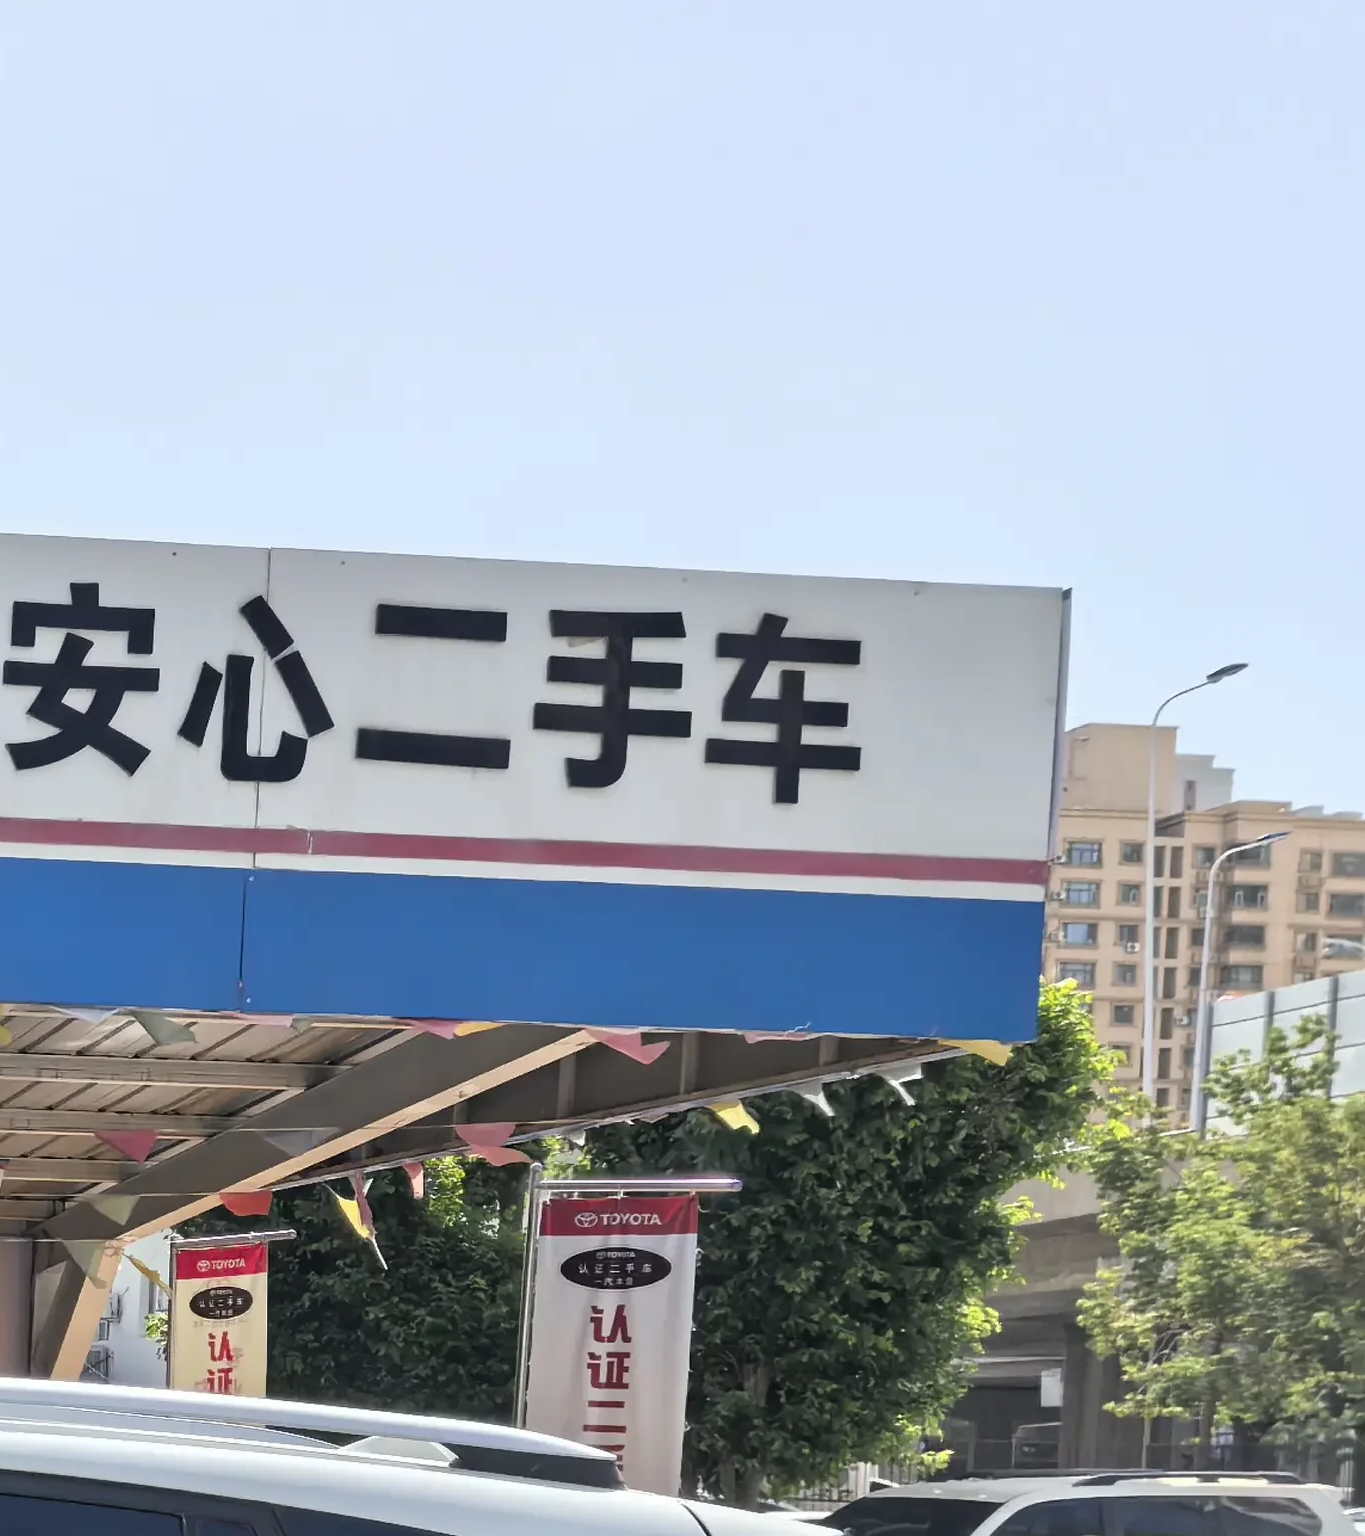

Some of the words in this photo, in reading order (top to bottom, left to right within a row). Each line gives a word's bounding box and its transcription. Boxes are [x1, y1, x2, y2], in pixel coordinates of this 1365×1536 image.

[599, 1212, 662, 1227] TOYOTA
[210, 1257, 247, 1272] TOYOTA
[206, 1330, 235, 1394] 认证
